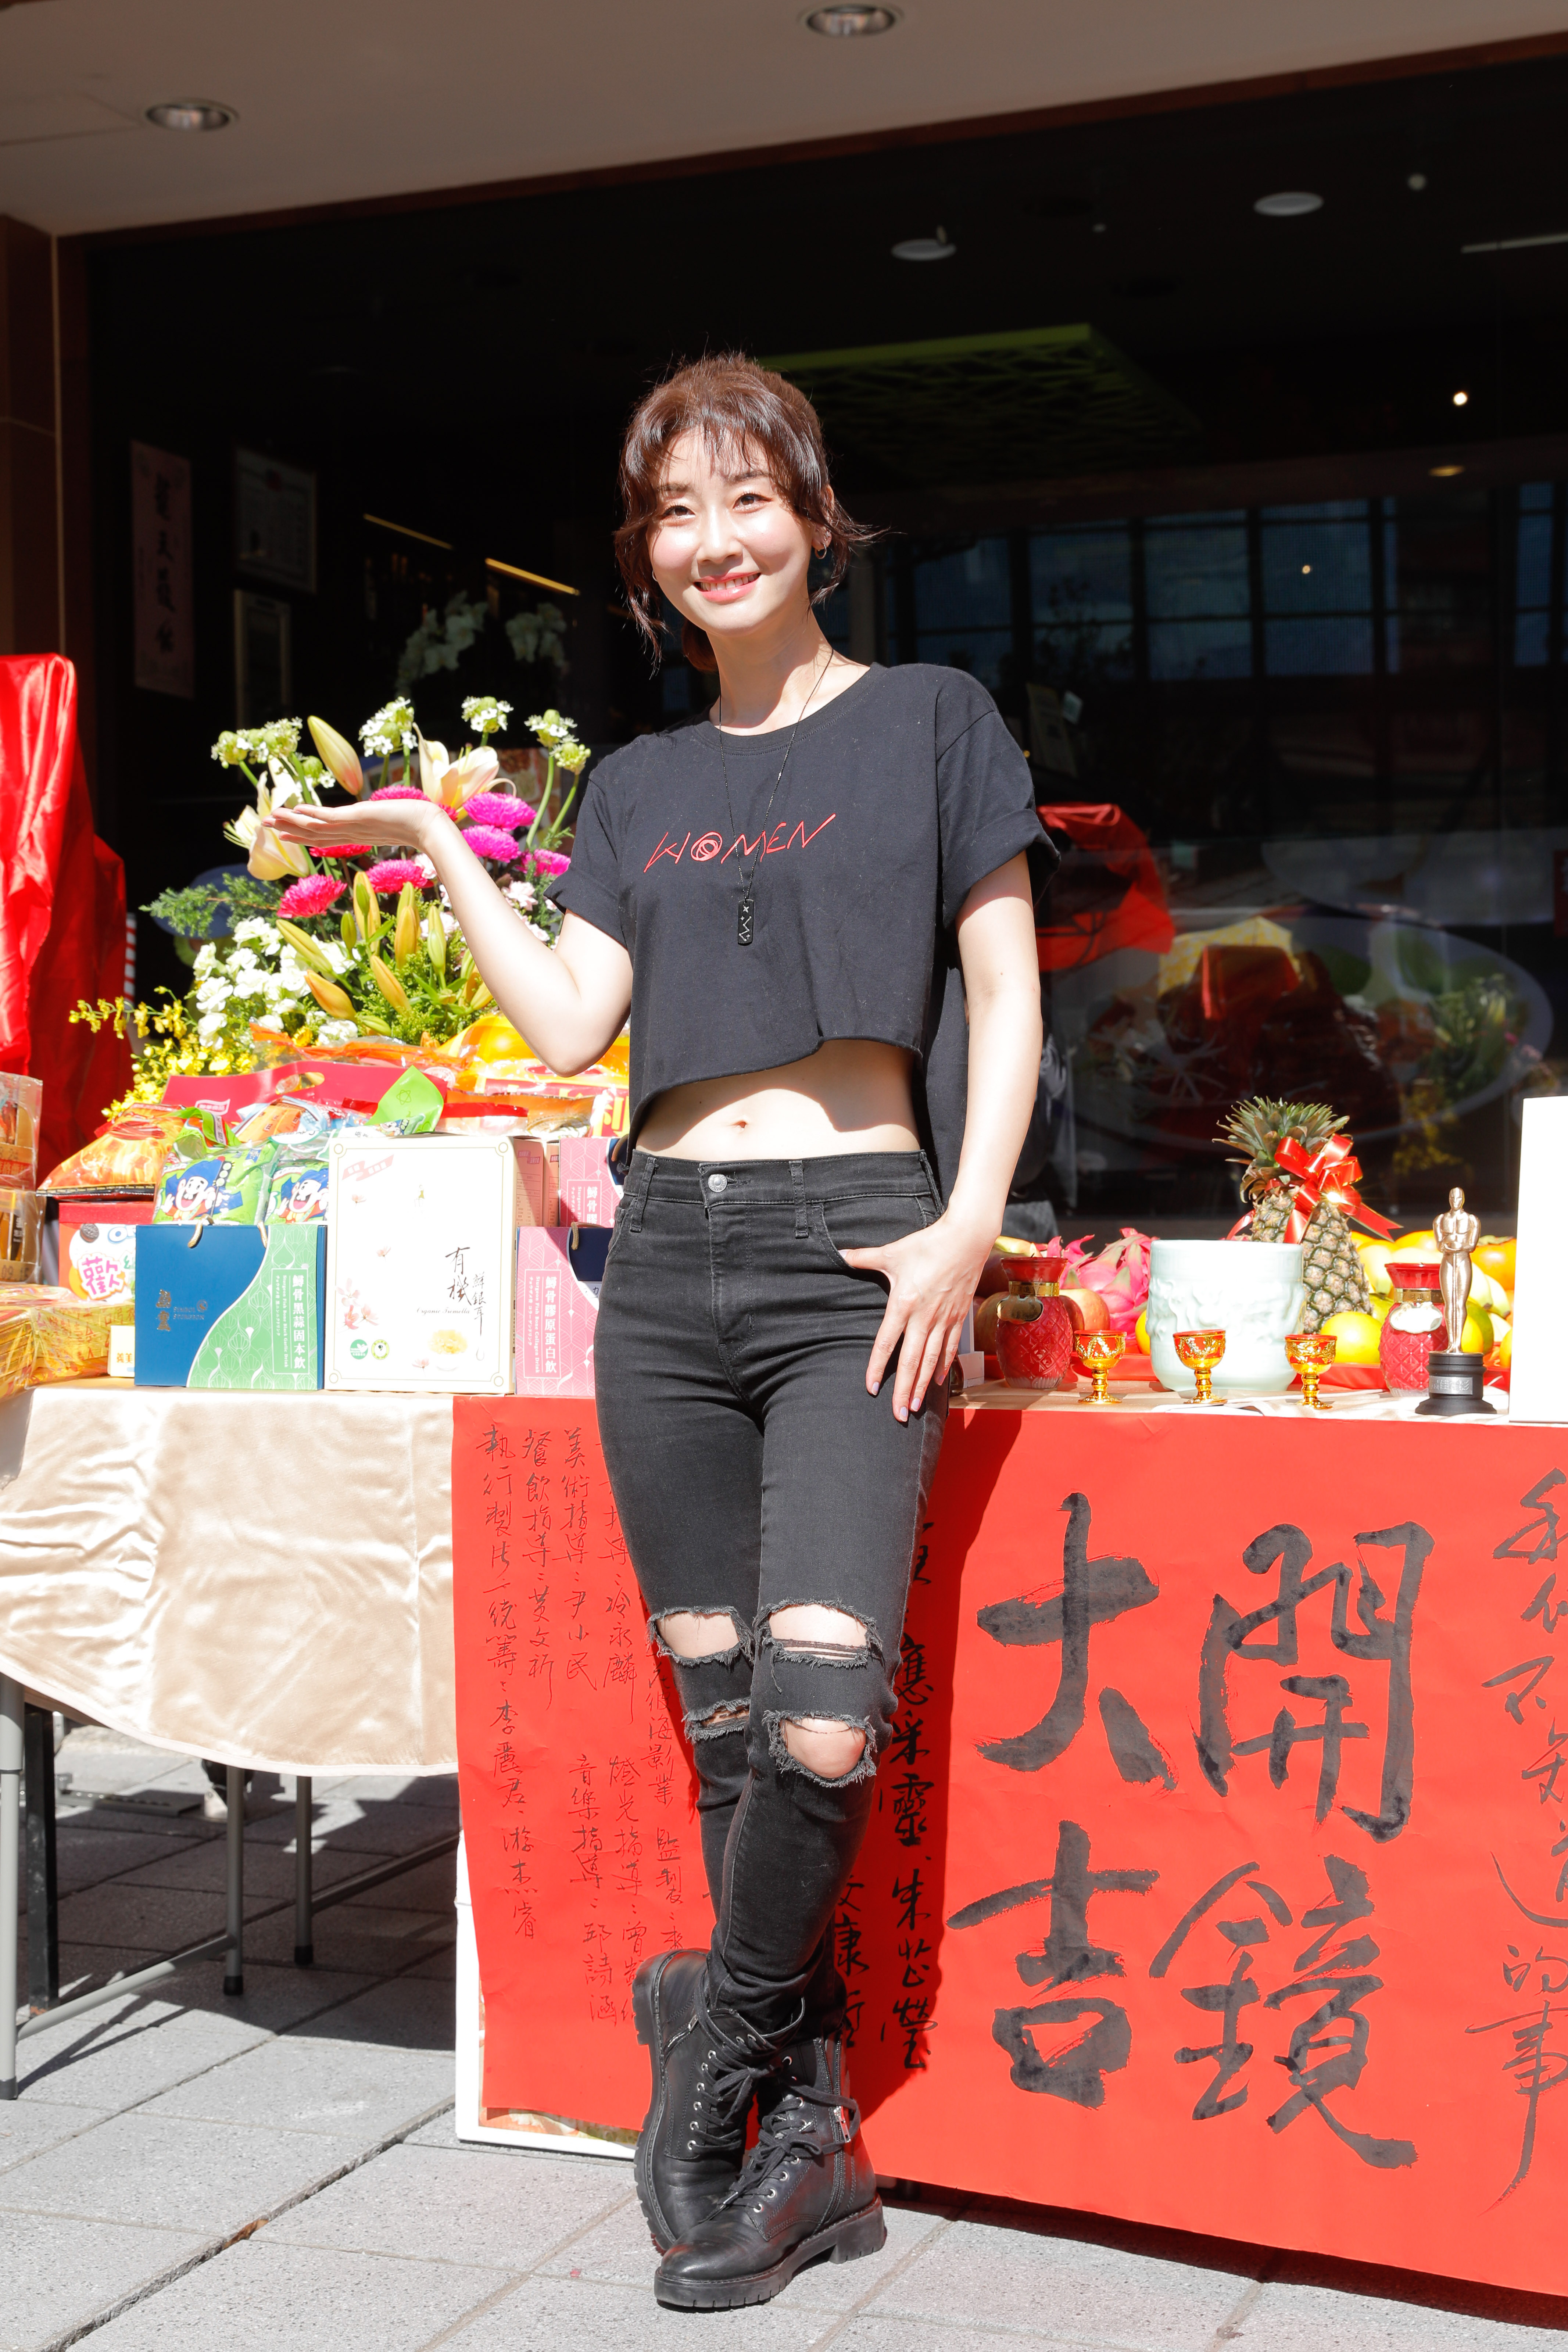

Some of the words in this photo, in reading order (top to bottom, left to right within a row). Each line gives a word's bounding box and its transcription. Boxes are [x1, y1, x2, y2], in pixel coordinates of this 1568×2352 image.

[445, 1247, 472, 1306] 有機
[472, 1271, 486, 1336] 鮮銀耳
[545, 1276, 557, 1374] 鱘骨膠原蛋白飲
[116, 1353, 133, 1364] 義美
